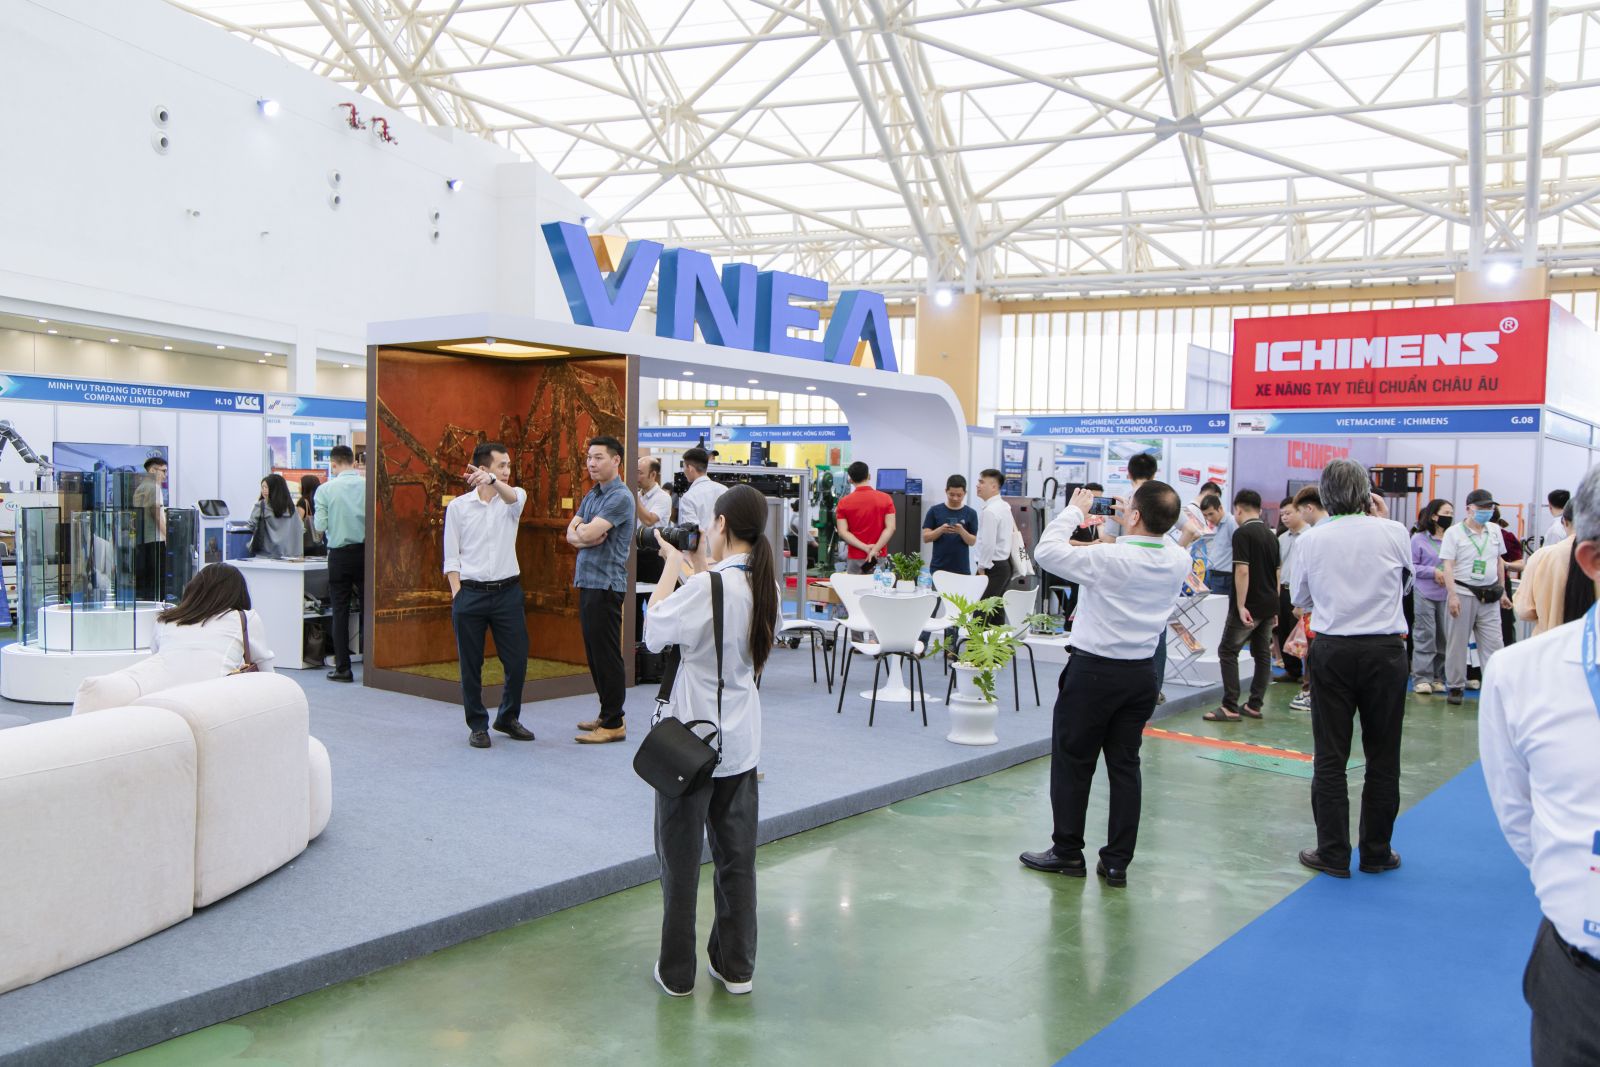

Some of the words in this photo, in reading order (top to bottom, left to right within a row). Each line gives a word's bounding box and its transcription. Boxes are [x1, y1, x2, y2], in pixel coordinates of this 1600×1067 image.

[541, 221, 898, 372] VNEA
[1254, 331, 1500, 372] ICHIMENS
[48, 381, 73, 391] MINH
[75, 383, 88, 392] VU
[90, 384, 129, 395] TRADING
[130, 387, 191, 399] DEVELOPMENT
[1255, 383, 1272, 396] XE
[1315, 381, 1341, 395] TAY
[1345, 378, 1374, 394] TIÊU
[1379, 374, 1427, 394] CHUẨN
[1432, 375, 1472, 392] CHÂU
[1478, 374, 1499, 391] ÂU
[84, 392, 128, 403] COMPANY
[129, 396, 163, 405] LIMITED
[215, 397, 233, 406] H.10
[1208, 420, 1226, 428] G.39
[1336, 417, 1396, 426] VIETMACHINE
[1403, 417, 1449, 426] ICHIMENS
[1510, 416, 1534, 425] G.08
[1049, 426, 1074, 434] UNITED
[1074, 425, 1114, 434] INDUSTRIAL
[1116, 425, 1163, 433] TECHNOLOGY
